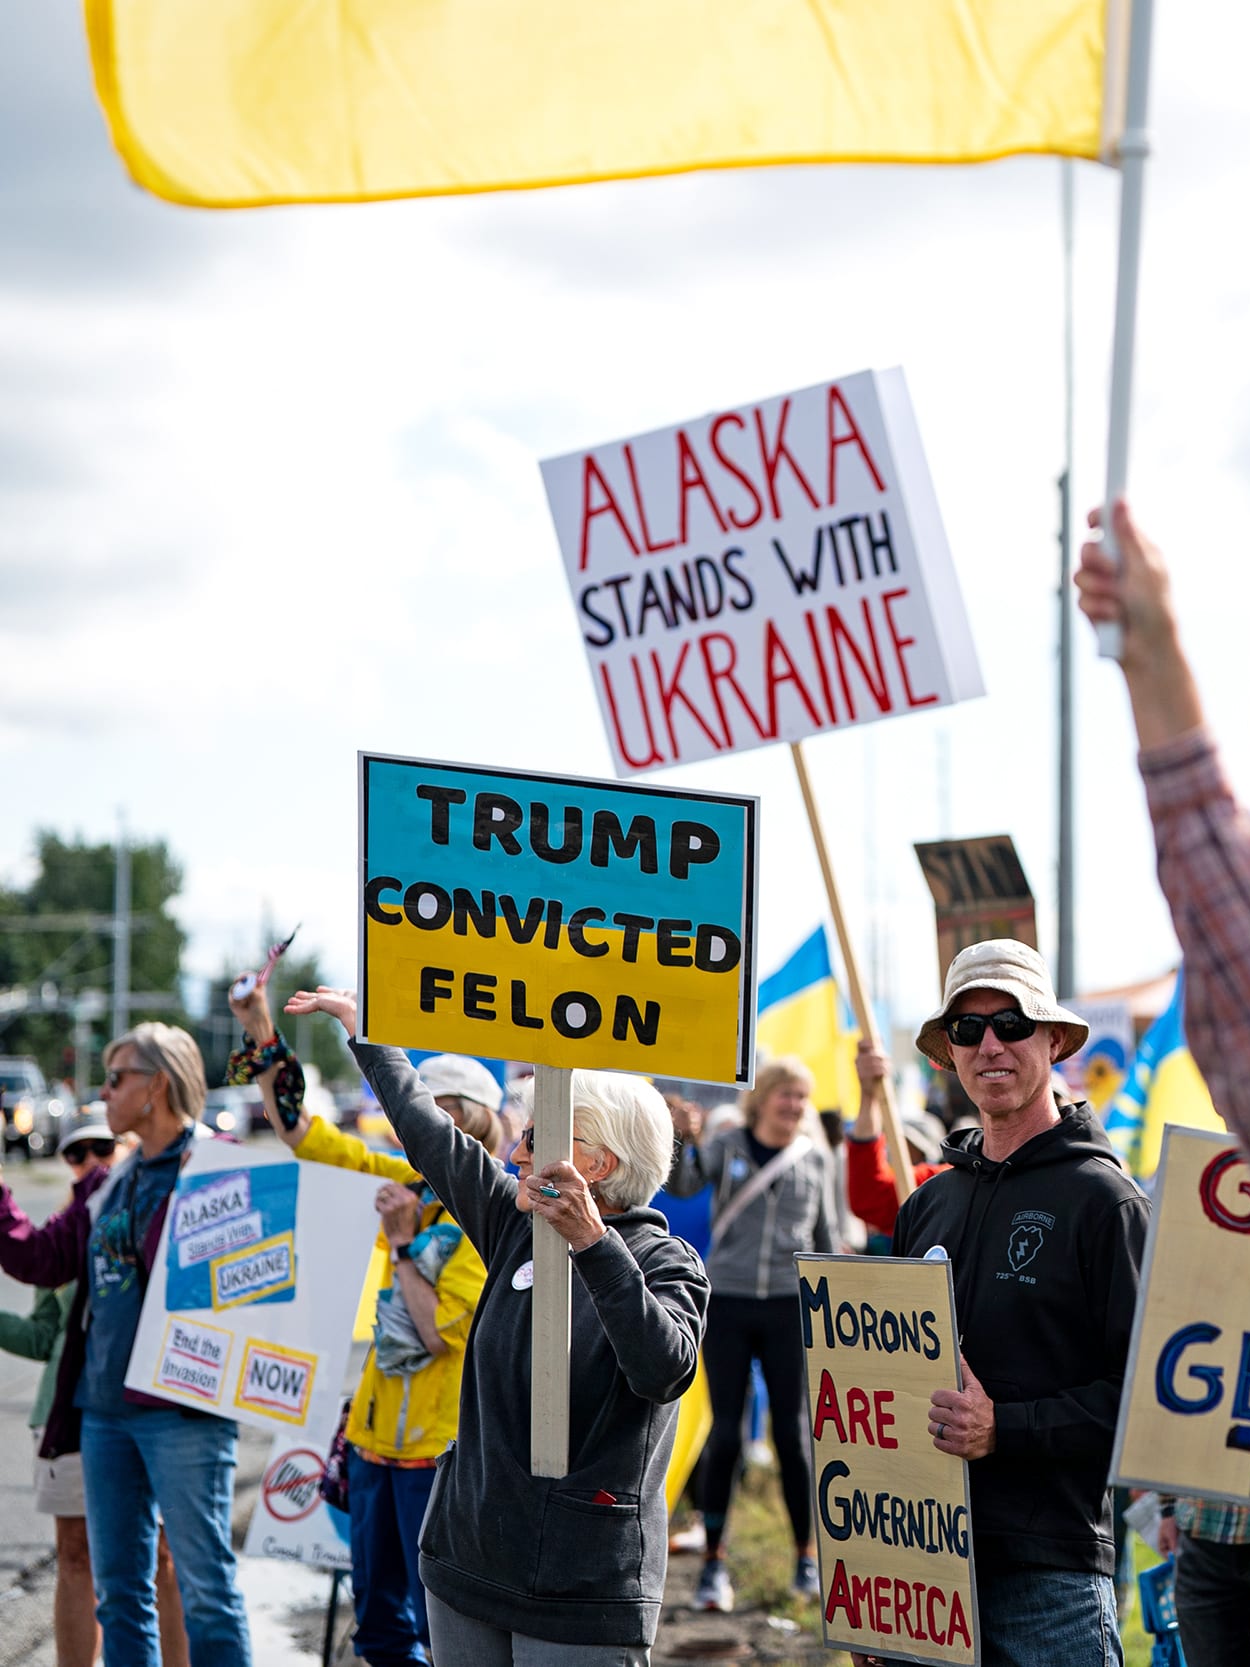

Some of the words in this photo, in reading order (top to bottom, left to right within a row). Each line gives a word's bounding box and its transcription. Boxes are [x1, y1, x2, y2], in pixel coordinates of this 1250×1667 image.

[579, 384, 886, 572] ALASKA
[580, 546, 753, 649] STANDS
[773, 510, 898, 597] WITH
[600, 587, 938, 769] UKRAINE
[416, 784, 721, 879] TRUMP
[365, 876, 741, 974] CONVICTED
[420, 966, 661, 1045] FELON
[178, 1188, 244, 1232] ALASKA
[1015, 1212, 1052, 1225] AIRBORNE
[219, 1255, 287, 1292] UKRAINE
[1019, 1275, 1036, 1284] BSB
[172, 1327, 199, 1352] End
[201, 1334, 221, 1360] the
[800, 1276, 940, 1360] MORONS
[250, 1358, 306, 1397] NOW
[813, 1369, 898, 1449] ARE
[818, 1460, 969, 1559] GOVERNING
[825, 1559, 971, 1648] AMERICA
